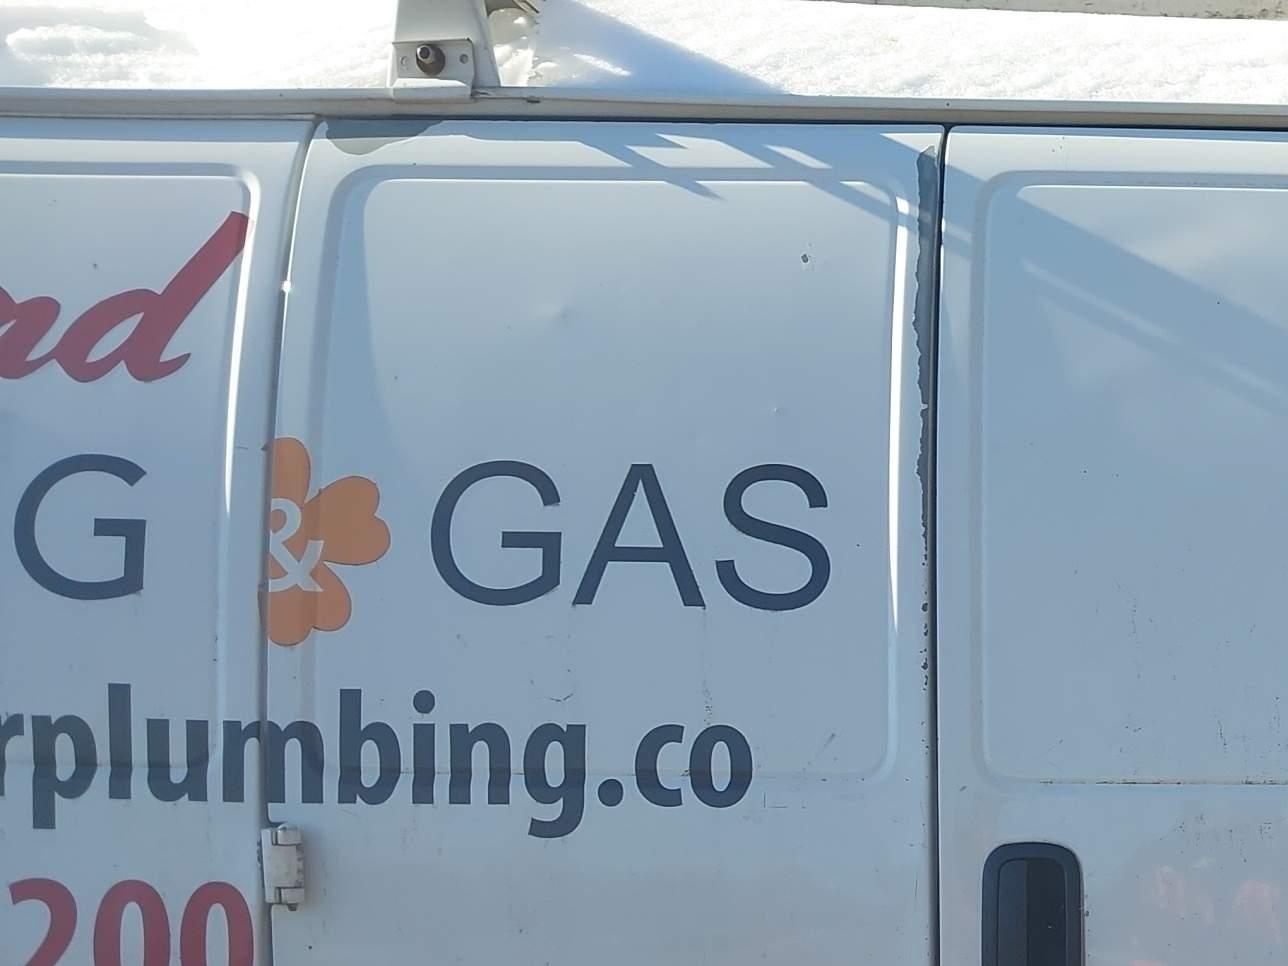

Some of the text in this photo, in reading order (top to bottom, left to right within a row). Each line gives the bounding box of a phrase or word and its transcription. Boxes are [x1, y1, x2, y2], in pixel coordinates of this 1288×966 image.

[13, 453, 832, 611] G & GAS
